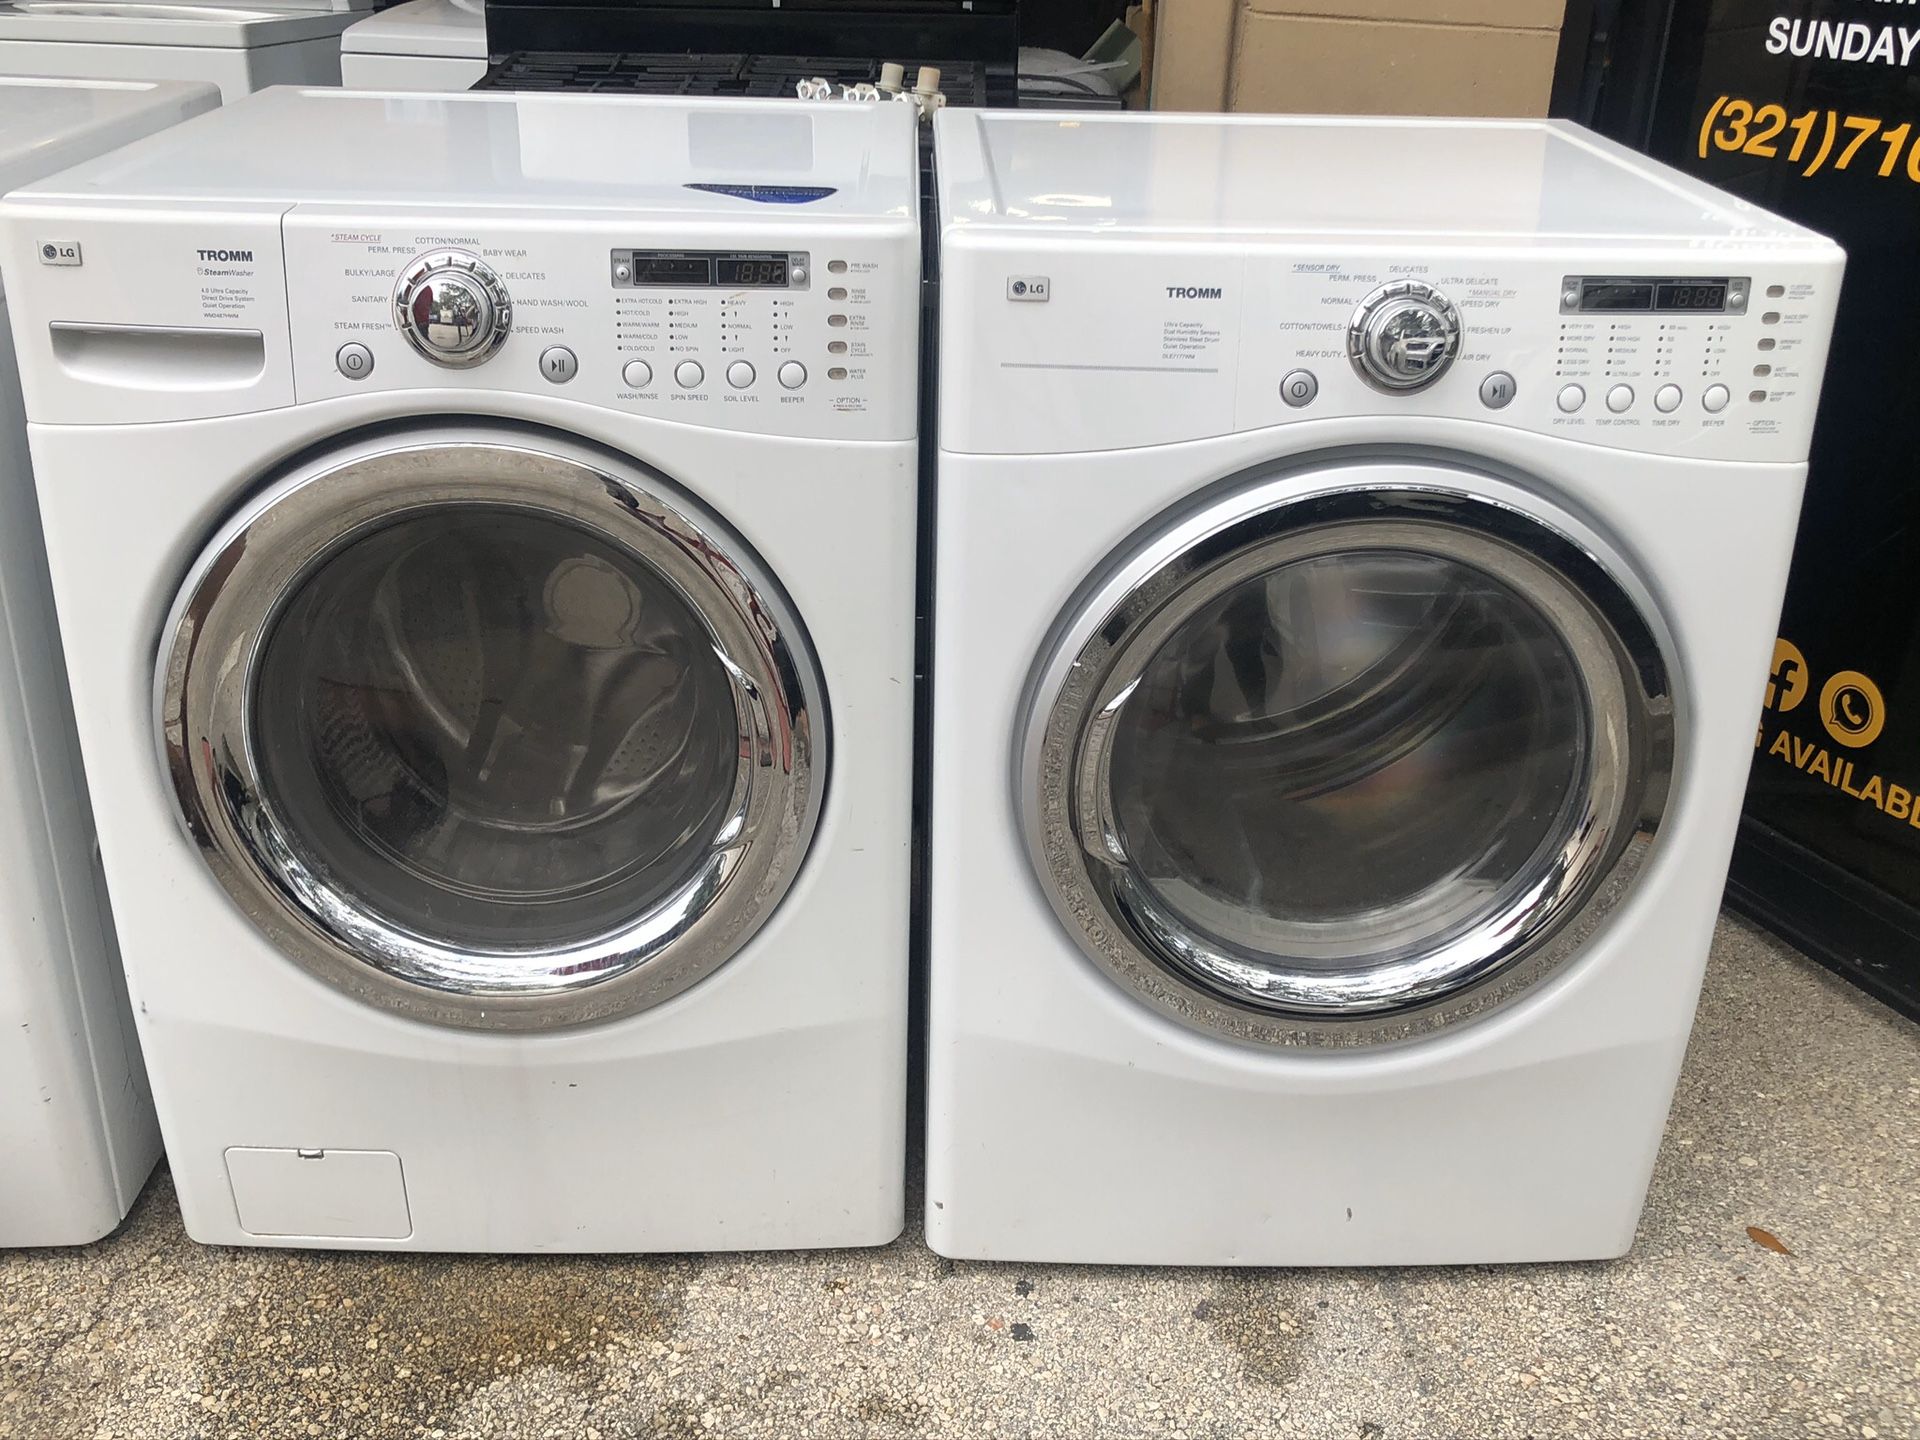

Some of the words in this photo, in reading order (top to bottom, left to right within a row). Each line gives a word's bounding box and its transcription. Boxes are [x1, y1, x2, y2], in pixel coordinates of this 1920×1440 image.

[1765, 16, 1920, 66] SUNDAY
[415, 237, 480, 245] COTTON/NORMAL
[60, 248, 75, 258] LG
[368, 246, 391, 254] PERM.
[392, 247, 416, 255] PRESS
[483, 249, 503, 257] BABY
[505, 249, 527, 258] WEAR
[196, 249, 253, 262] TROMM
[203, 267, 254, 277] SteamWasher
[1324, 264, 1341, 272] DRY
[1389, 265, 1429, 274] DELICATES
[344, 269, 395, 278] BULKY/LARGE
[505, 272, 546, 280] DELICATES
[1328, 275, 1351, 283] PERM.
[1353, 275, 1377, 283] PRESS
[1440, 278, 1464, 286] ULTRA
[1465, 278, 1499, 286] DELICATE
[1029, 284, 1044, 294] LG
[1166, 286, 1222, 299] TROMM
[1502, 289, 1517, 297] DRY
[351, 295, 388, 303] SANITARY
[516, 299, 538, 307] HAND
[539, 299, 589, 308] WASH/WOOL
[1320, 298, 1353, 306] NORMAL
[1460, 300, 1481, 308] SPEED
[1481, 300, 1500, 308] DRY
[334, 321, 361, 330] STEAM
[1279, 322, 1342, 331] COTTON/TOWELS
[515, 326, 540, 334] SPEED
[541, 327, 565, 335] WASH
[1466, 327, 1499, 335] FRESHEN
[1500, 327, 1511, 335] UP
[1295, 350, 1320, 359] HEAVY
[1320, 350, 1342, 359] DUTY
[1462, 353, 1474, 361] AIR
[1475, 354, 1491, 362] DRY
[616, 393, 659, 401] WASH/RINSE
[670, 394, 686, 402] SPIN
[687, 394, 709, 402] SPEED
[723, 395, 739, 403] SOIL
[740, 395, 760, 403] LEVEL
[780, 396, 805, 404] BEEPER
